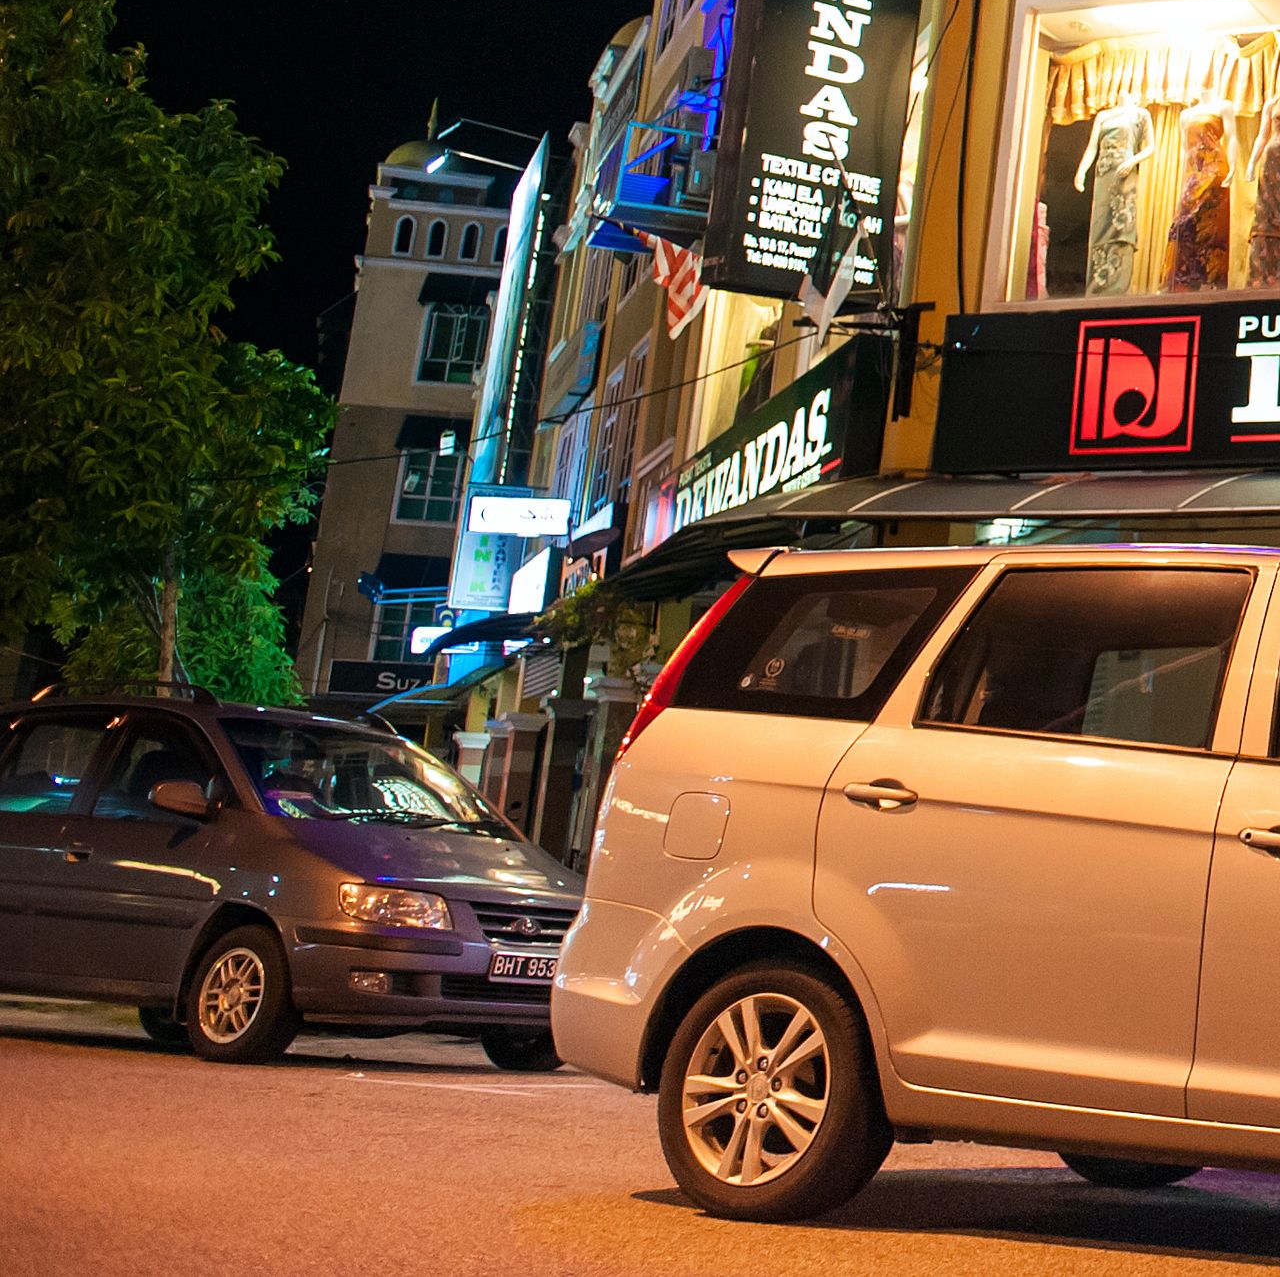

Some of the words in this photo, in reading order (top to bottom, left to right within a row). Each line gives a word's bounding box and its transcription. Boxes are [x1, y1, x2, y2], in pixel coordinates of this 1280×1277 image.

[761, 152, 822, 184] TEXTILE
[760, 194, 821, 223] UNIFORM
[796, 184, 824, 206] ELA
[758, 211, 799, 235] BATIK
[799, 220, 823, 240] DLL
[674, 387, 833, 534] DEWANDAS
[493, 955, 525, 977] BHT
